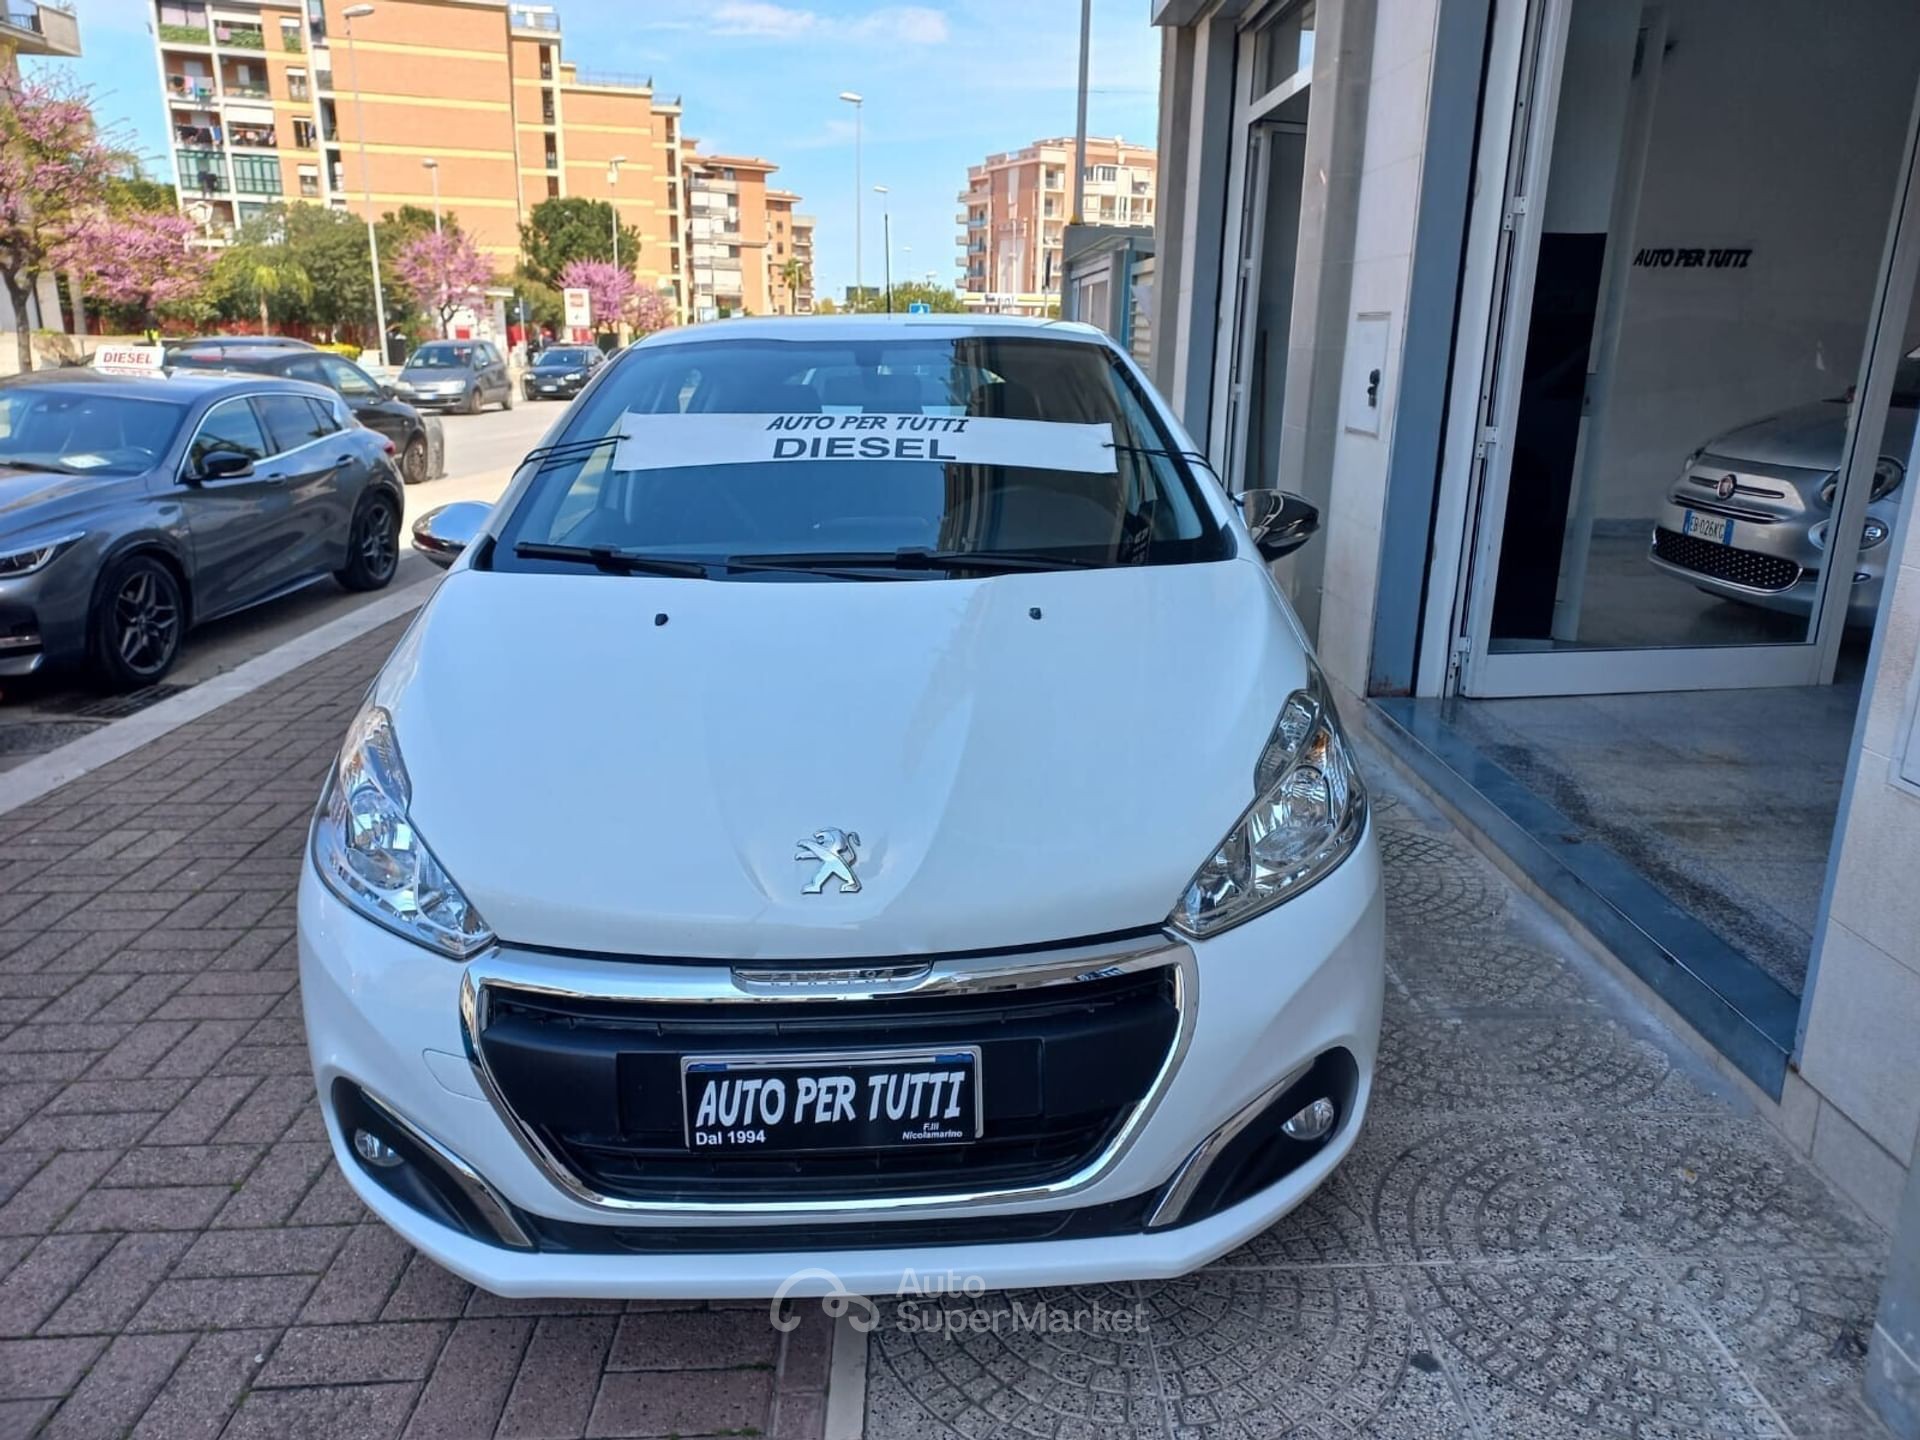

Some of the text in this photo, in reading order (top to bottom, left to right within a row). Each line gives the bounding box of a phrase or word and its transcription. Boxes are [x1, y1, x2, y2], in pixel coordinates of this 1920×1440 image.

[1632, 248, 1753, 268] AUTO PER TUTTI
[103, 352, 153, 364] DIESEL
[766, 416, 969, 433] AUTO PER TUTTI
[773, 436, 957, 460] DIESEL
[695, 1071, 966, 1128] AUTO PER TUTTI
[695, 1130, 767, 1146] Dal 1994
[902, 1129, 963, 1140] Nicolamarino
